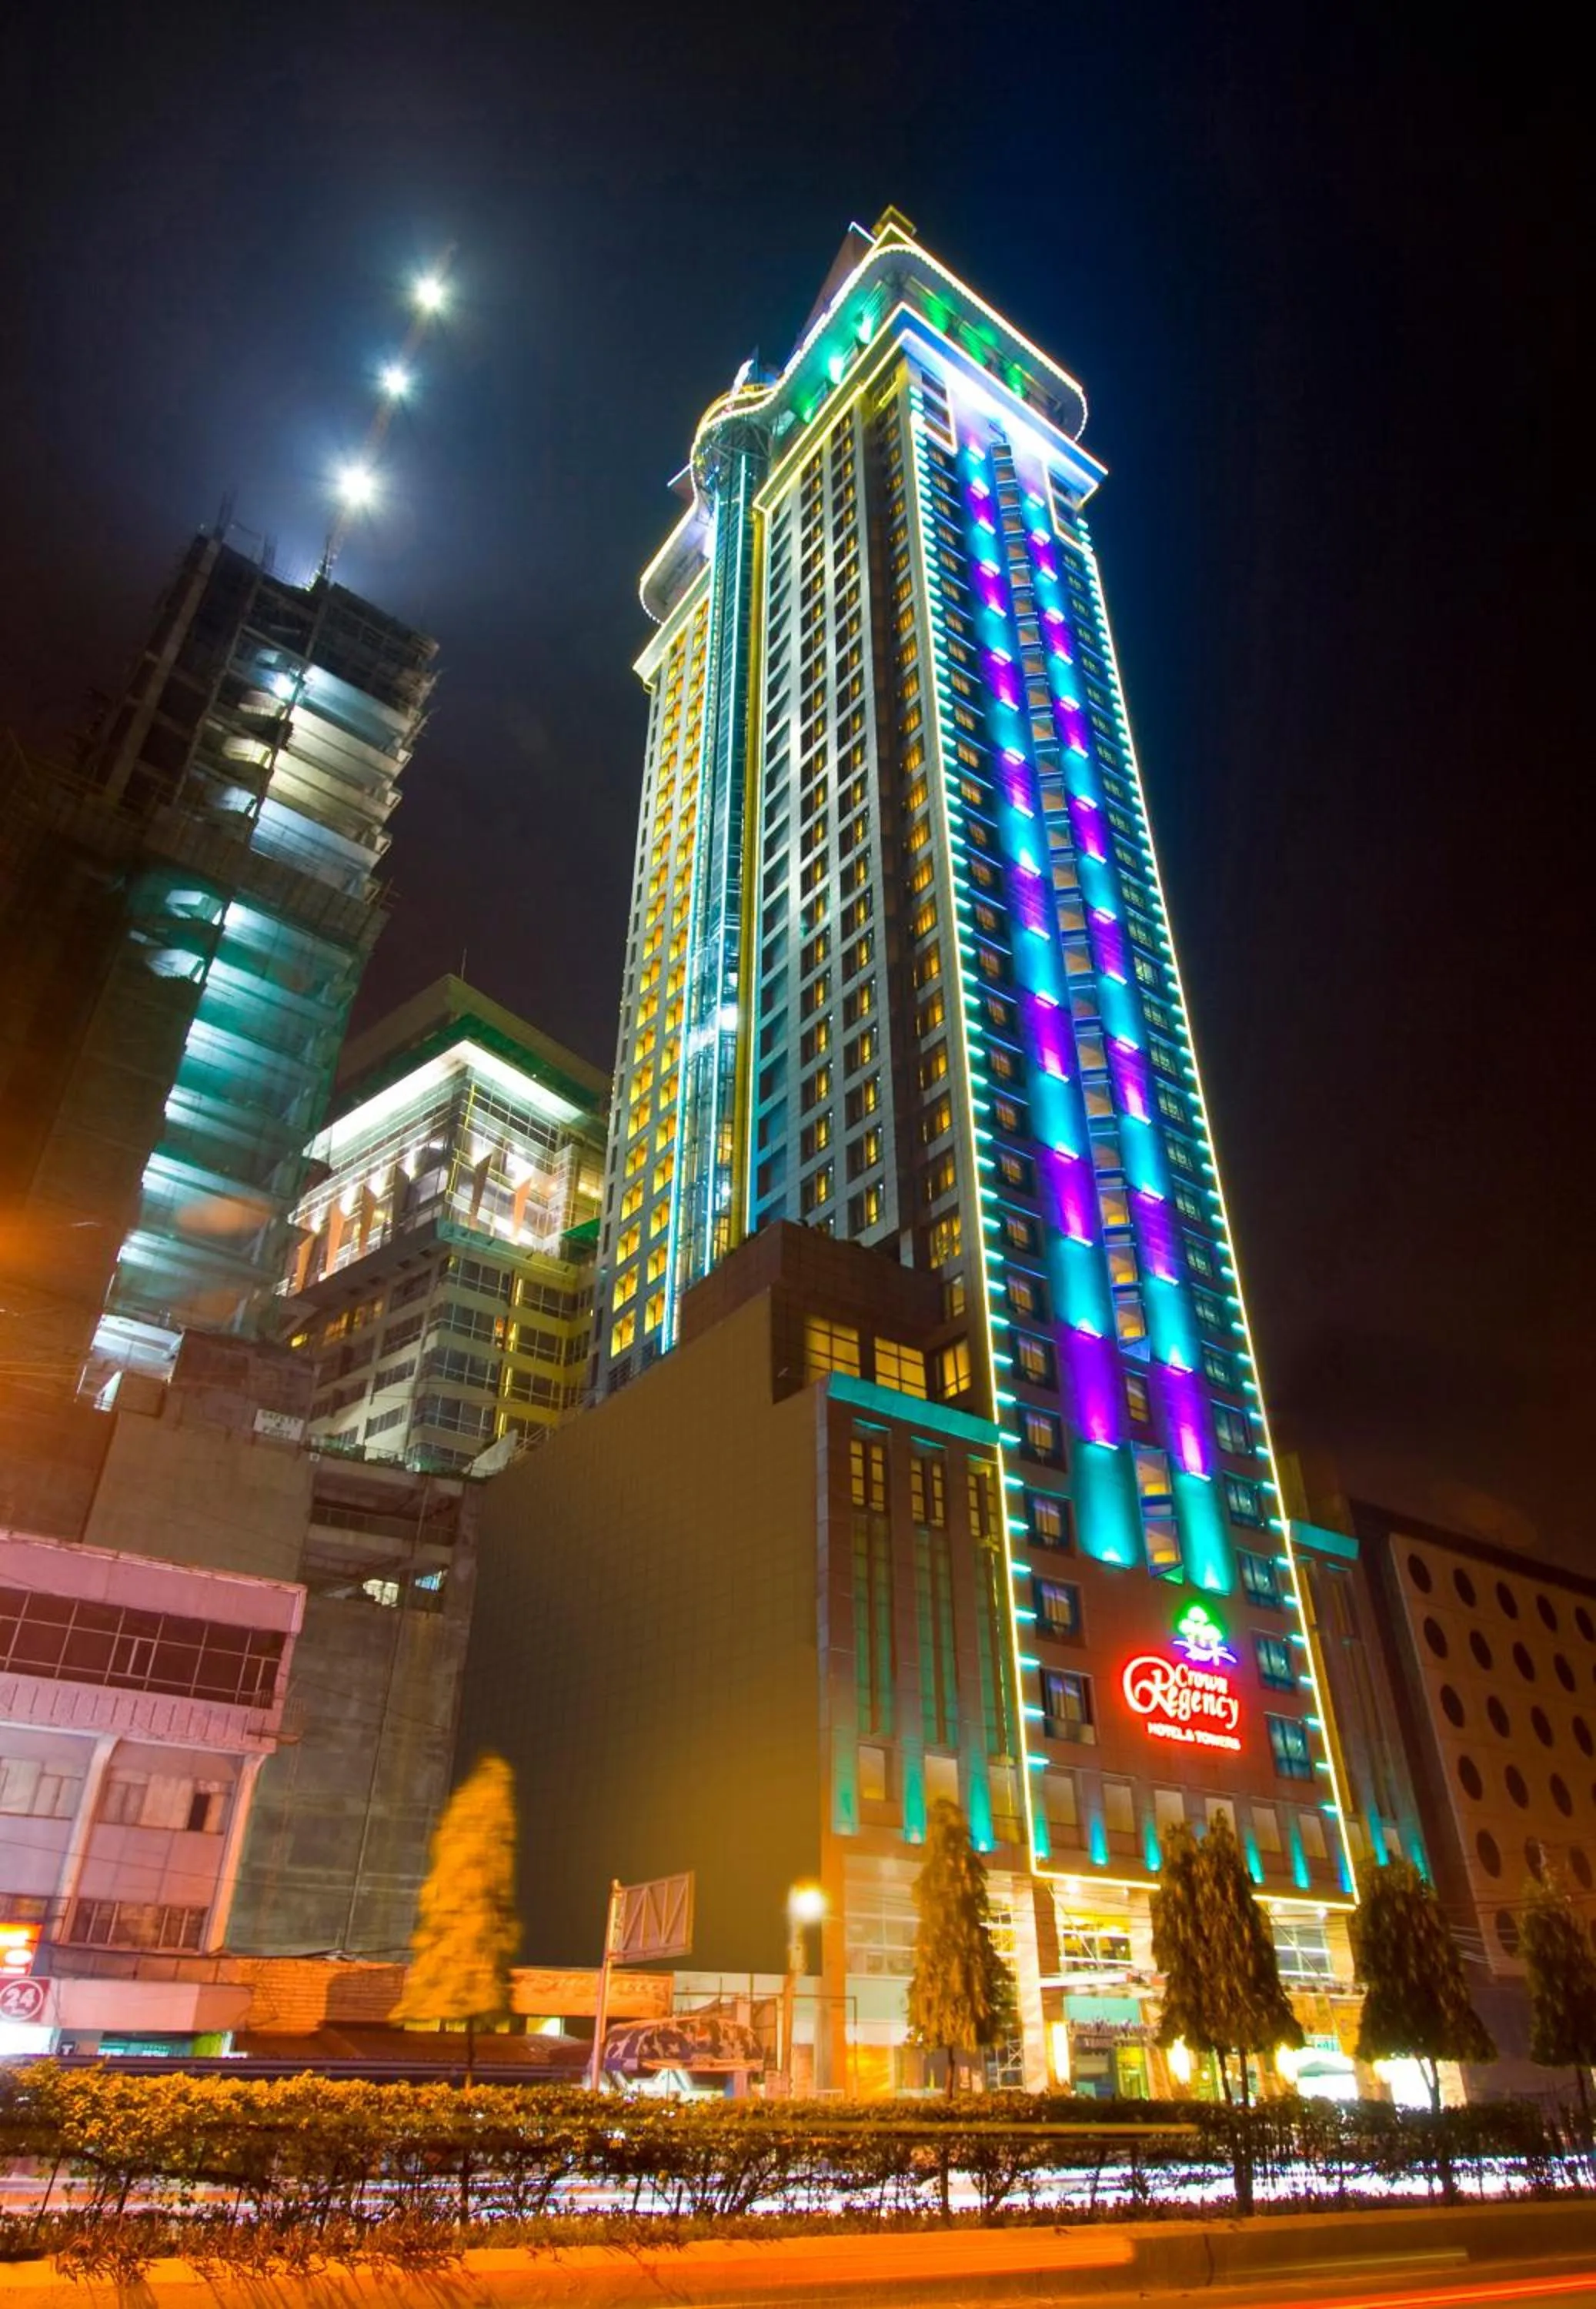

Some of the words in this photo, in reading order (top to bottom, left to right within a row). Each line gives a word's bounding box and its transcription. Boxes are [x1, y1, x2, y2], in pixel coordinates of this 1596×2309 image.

[1123, 1656, 1238, 1729] Regency
[1175, 1663, 1227, 1693] Crown
[1147, 1721, 1184, 1742] HOTEL
[1194, 1729, 1240, 1750] TOWERS
[4, 1987, 35, 2007] 24
